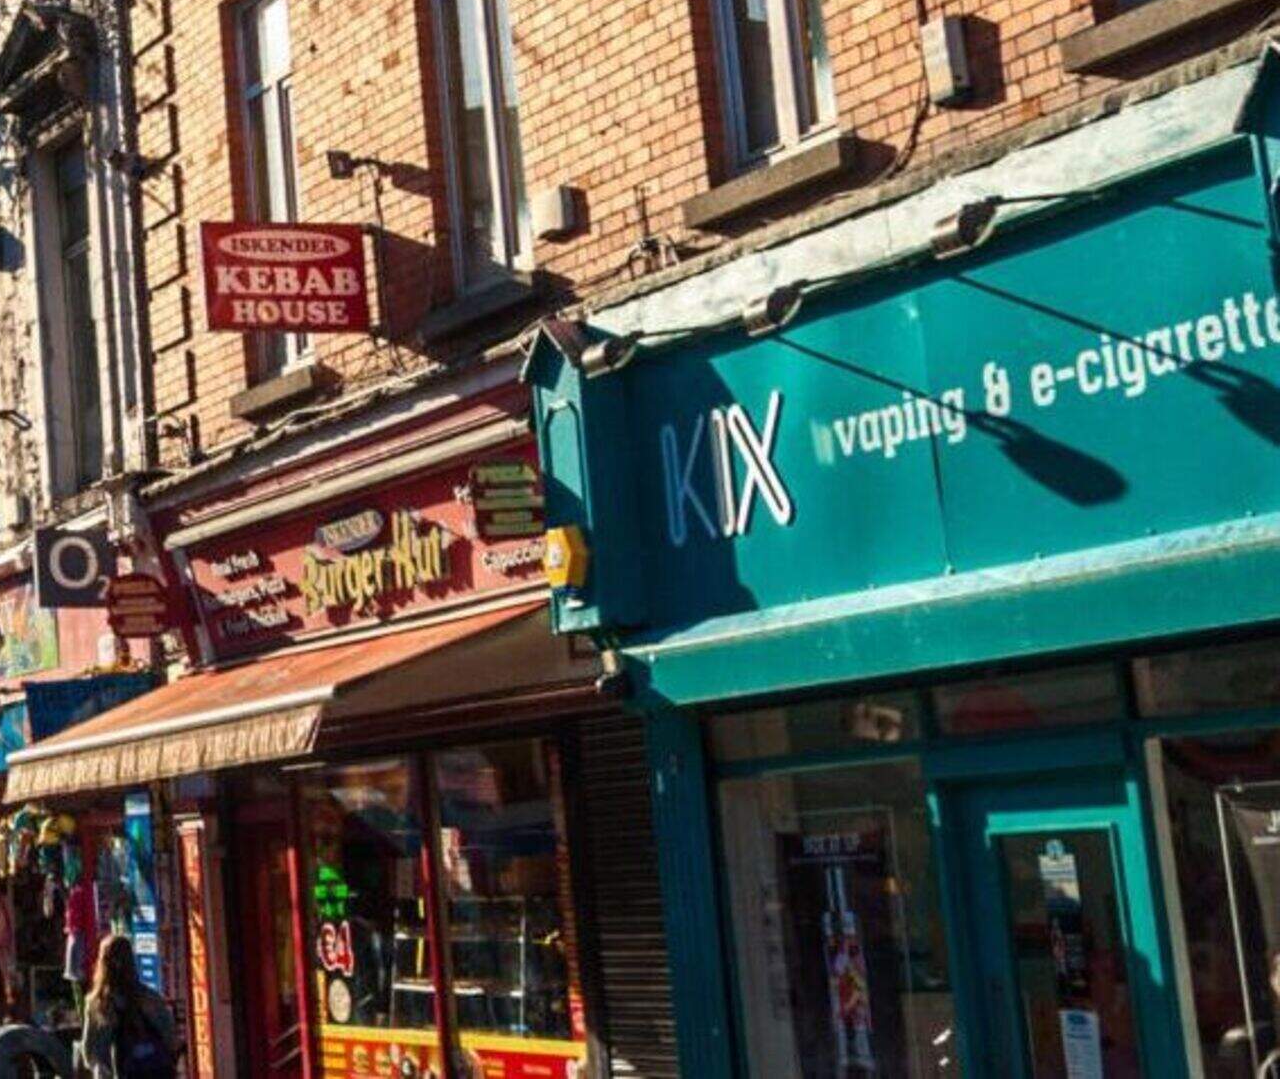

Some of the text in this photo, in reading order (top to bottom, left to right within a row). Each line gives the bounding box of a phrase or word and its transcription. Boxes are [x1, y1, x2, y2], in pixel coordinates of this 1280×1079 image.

[231, 237, 338, 254] ISKENDER
[216, 266, 361, 296] KEBAB
[232, 300, 349, 325] HOUSE
[833, 387, 967, 459] vaping
[659, 389, 791, 547] KIX
